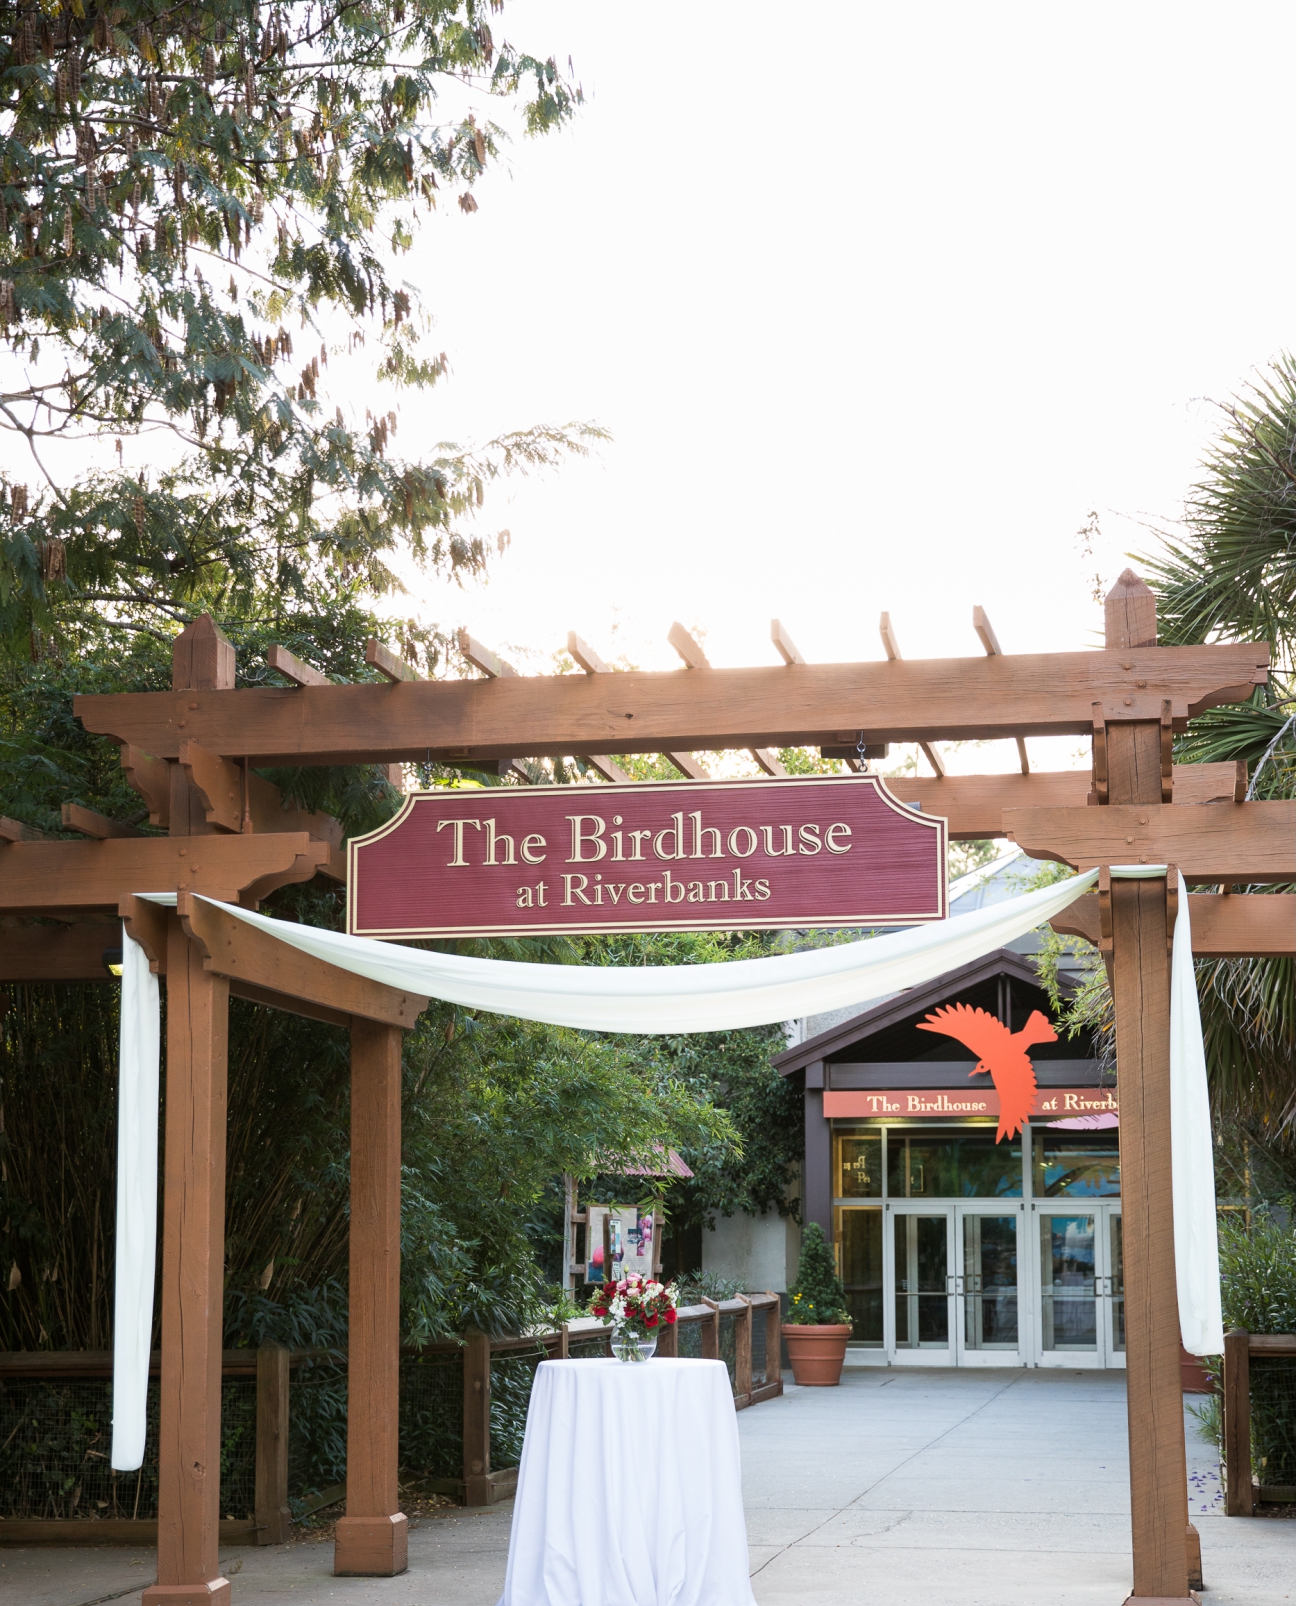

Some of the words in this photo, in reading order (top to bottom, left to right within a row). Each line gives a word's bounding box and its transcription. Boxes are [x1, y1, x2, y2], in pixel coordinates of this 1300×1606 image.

[436, 817, 547, 867] The
[564, 810, 853, 863] Birdhouse
[515, 880, 549, 908] at
[559, 867, 772, 907] Riverbanks
[866, 1095, 901, 1112] The
[906, 1094, 987, 1112] Birdhouse
[1041, 1096, 1058, 1111] at
[1063, 1093, 1119, 1111] Riverb
